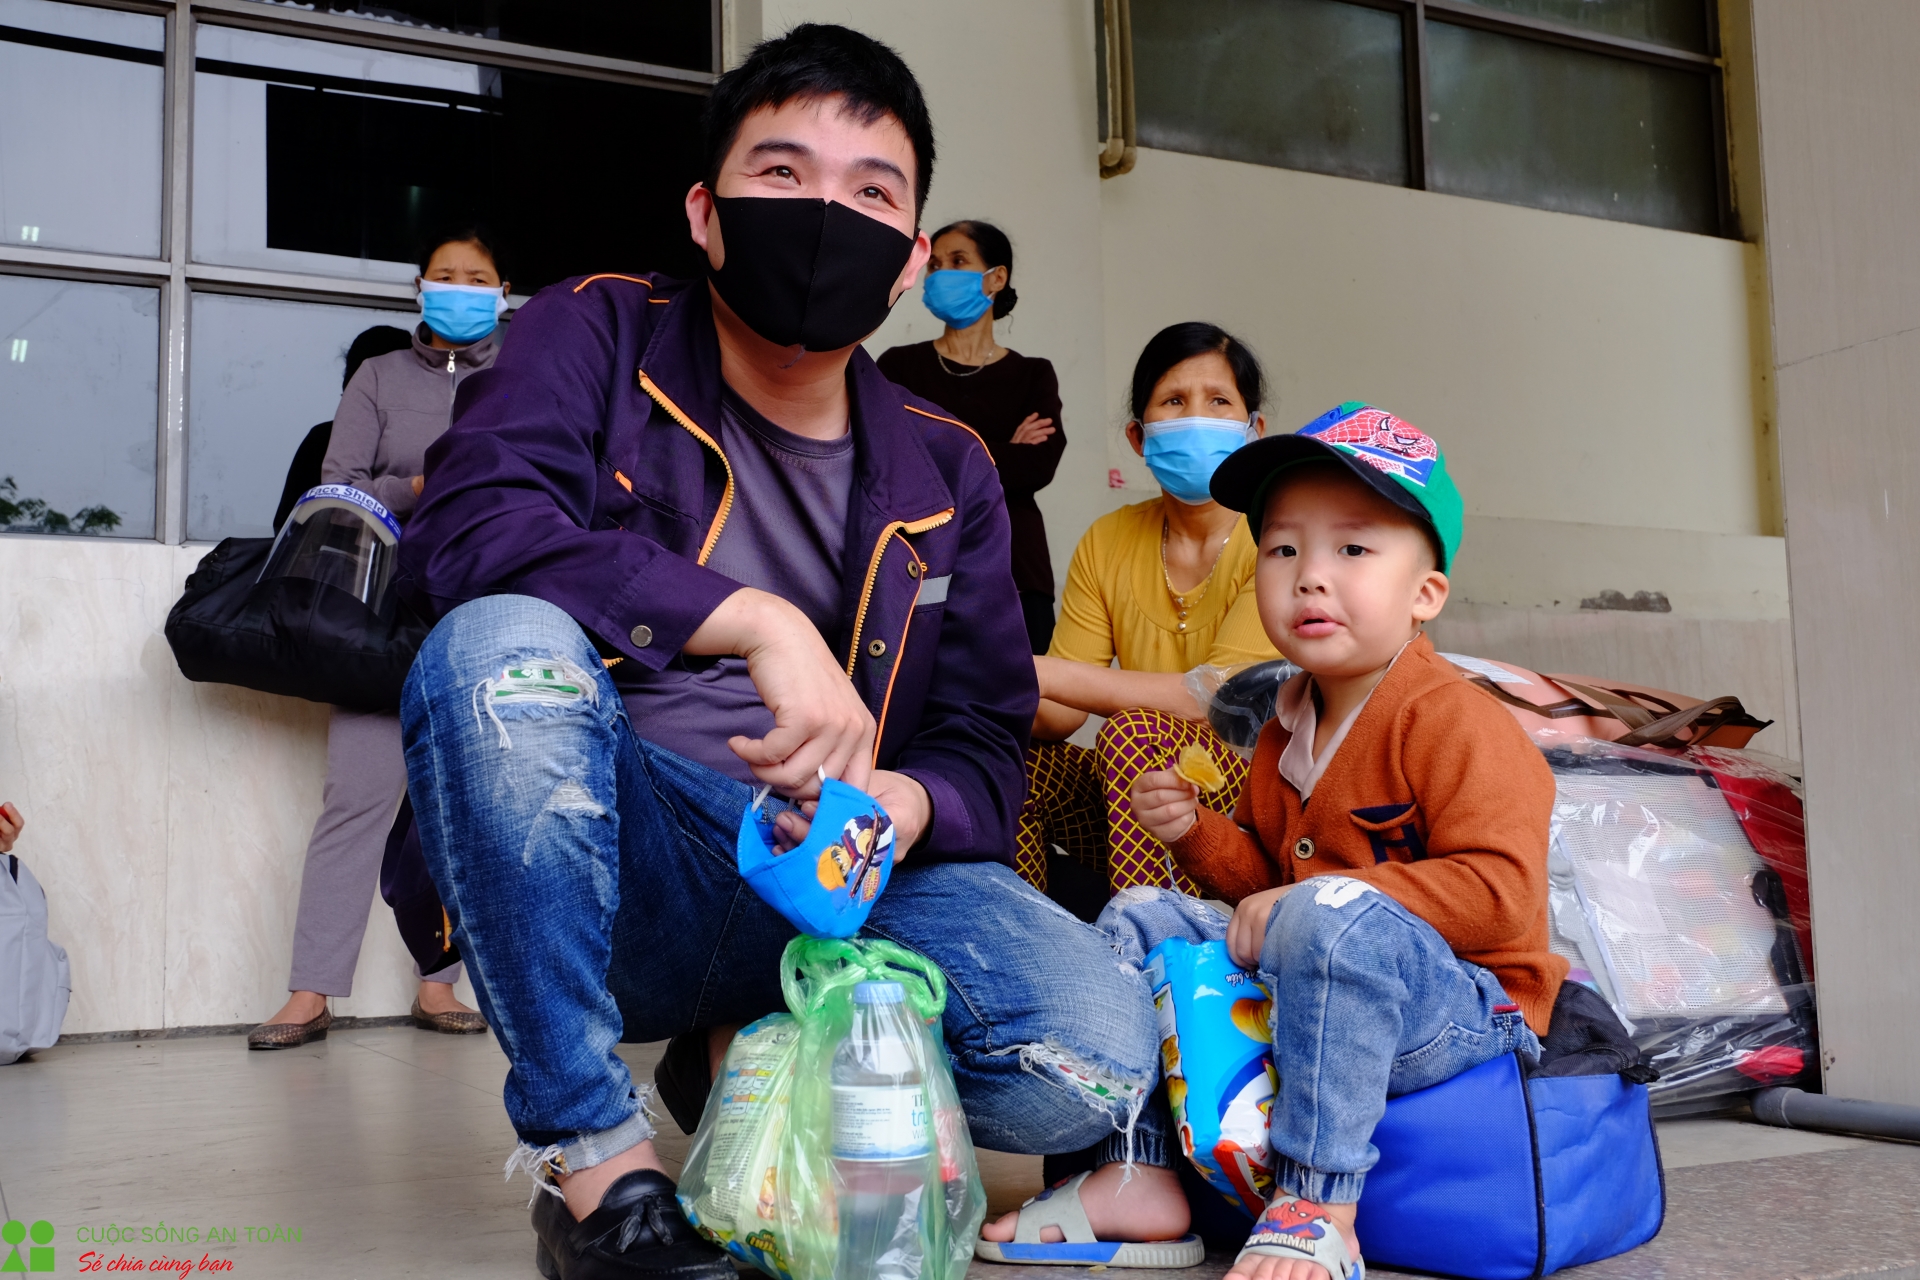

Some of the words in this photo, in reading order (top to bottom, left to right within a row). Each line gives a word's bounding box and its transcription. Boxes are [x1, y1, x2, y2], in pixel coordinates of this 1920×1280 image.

[308, 486, 339, 497] Face
[344, 487, 386, 516] Shield
[1246, 1232, 1315, 1254] SPIDERMAN
